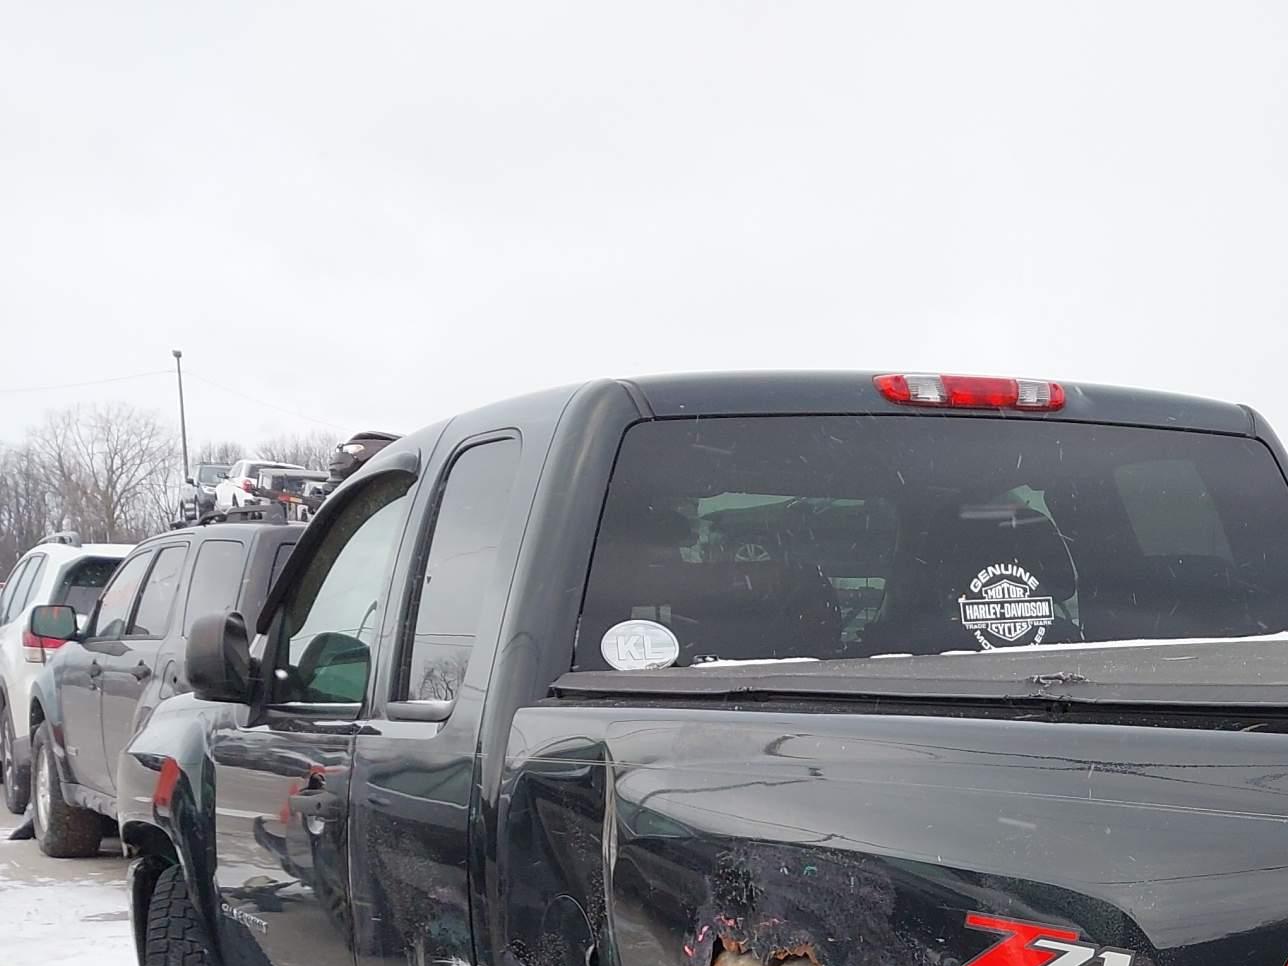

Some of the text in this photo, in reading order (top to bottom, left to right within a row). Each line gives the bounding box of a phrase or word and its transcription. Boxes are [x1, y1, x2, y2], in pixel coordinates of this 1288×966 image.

[970, 564, 1039, 593] GENUINE
[987, 585, 1025, 599] MOTOR
[965, 601, 1050, 620] HARLEY-DAVIDSON
[991, 622, 1028, 639] CYCLES
